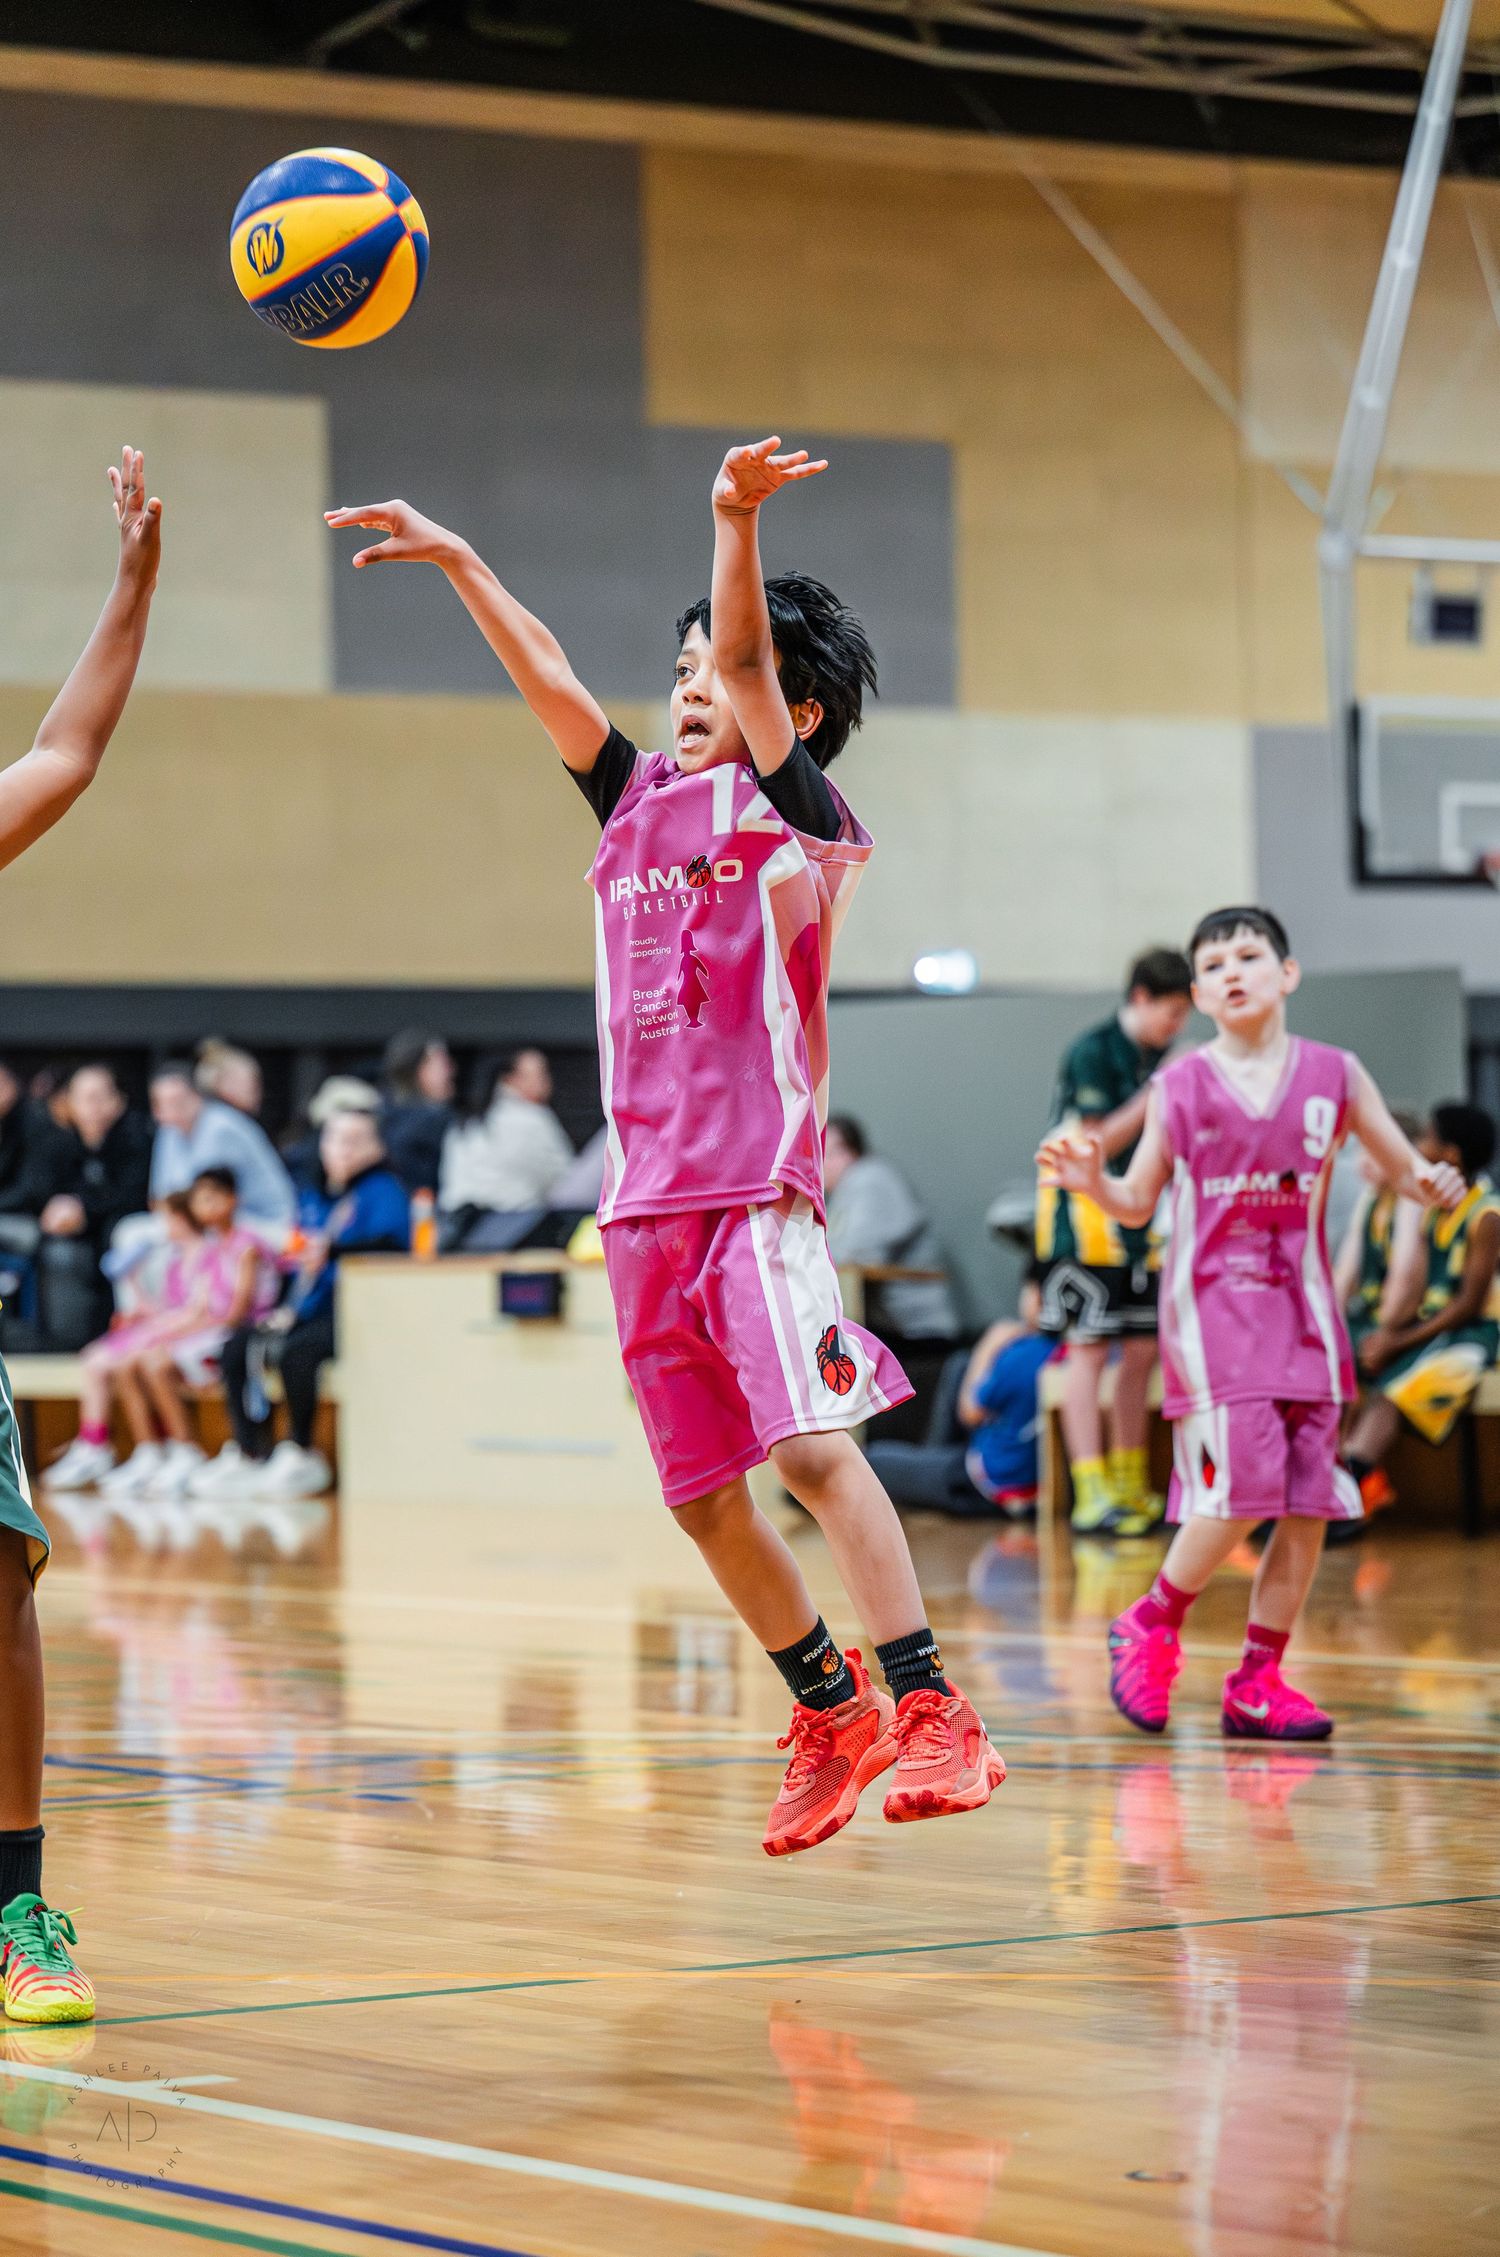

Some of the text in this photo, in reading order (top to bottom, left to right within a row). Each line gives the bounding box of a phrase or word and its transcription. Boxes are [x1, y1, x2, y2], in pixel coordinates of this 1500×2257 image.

[699, 762, 784, 836] 12
[609, 855, 743, 903] IRAMO
[623, 890, 723, 920] BSKETBALL
[632, 986, 666, 1001] Breast
[633, 999, 672, 1014] Cancer
[1303, 1095, 1337, 1160] 9
